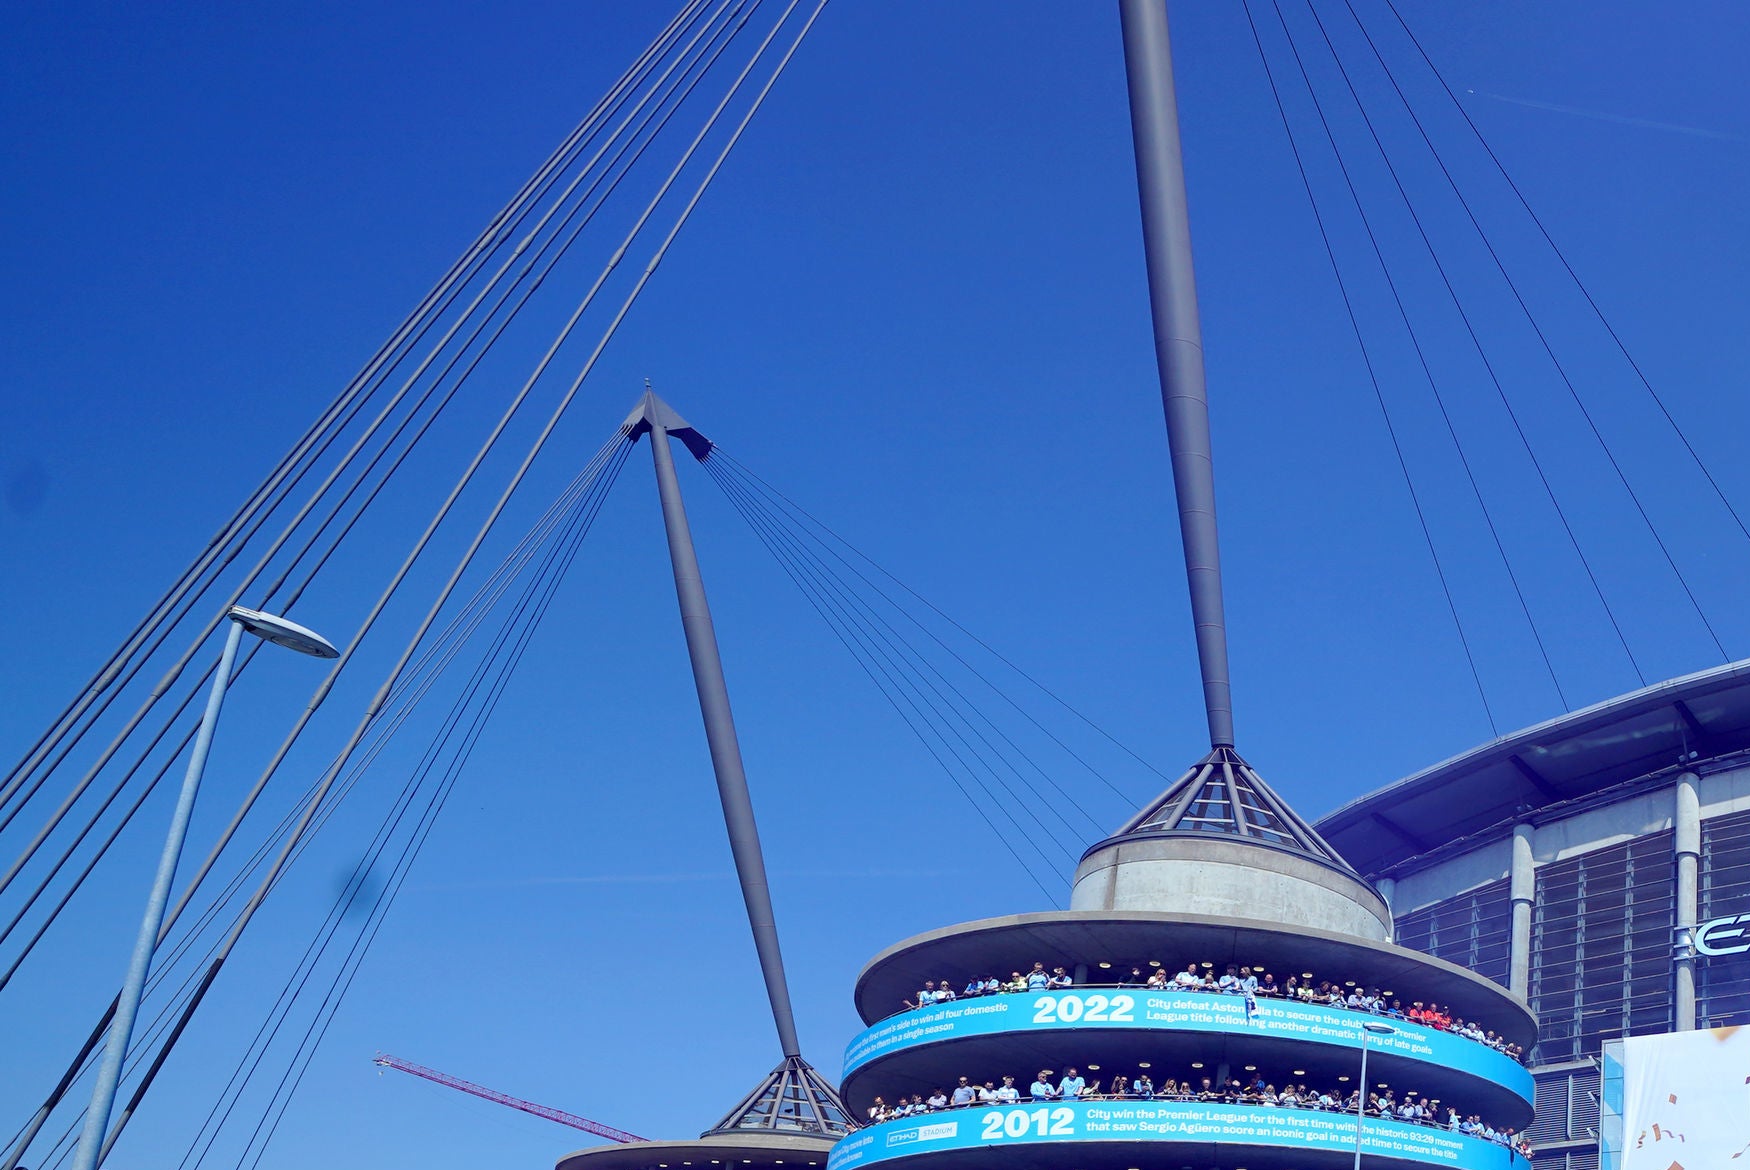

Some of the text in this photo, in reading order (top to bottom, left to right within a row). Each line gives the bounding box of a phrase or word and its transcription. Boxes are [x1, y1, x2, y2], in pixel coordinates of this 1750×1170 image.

[1033, 994, 1134, 1023] 2022
[1146, 998, 1209, 1012] City defeat
[1146, 1010, 1187, 1023] League
[981, 1107, 1075, 1140] 2012
[1087, 1109, 1248, 1124] City win the Premier League
[1086, 1121, 1255, 1135] that Sergio score
